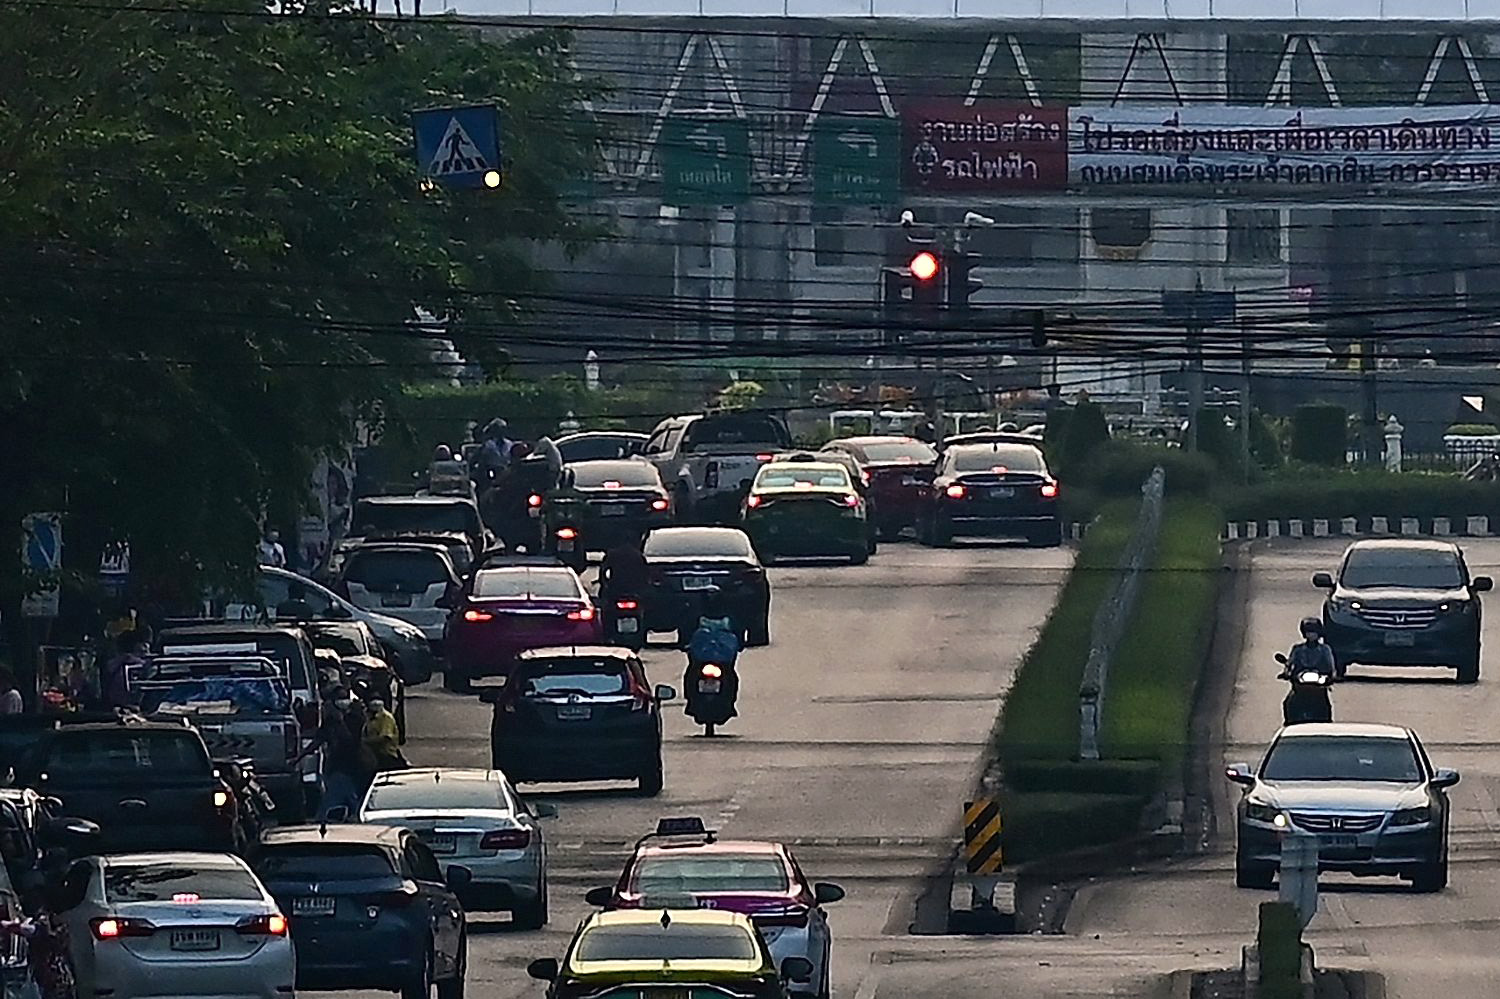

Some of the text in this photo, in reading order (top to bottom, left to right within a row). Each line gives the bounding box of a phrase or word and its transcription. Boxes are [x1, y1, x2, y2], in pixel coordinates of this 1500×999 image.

[920, 113, 1062, 142] งานก่อสร้าง
[941, 152, 1040, 180] รถไฟฟ้า
